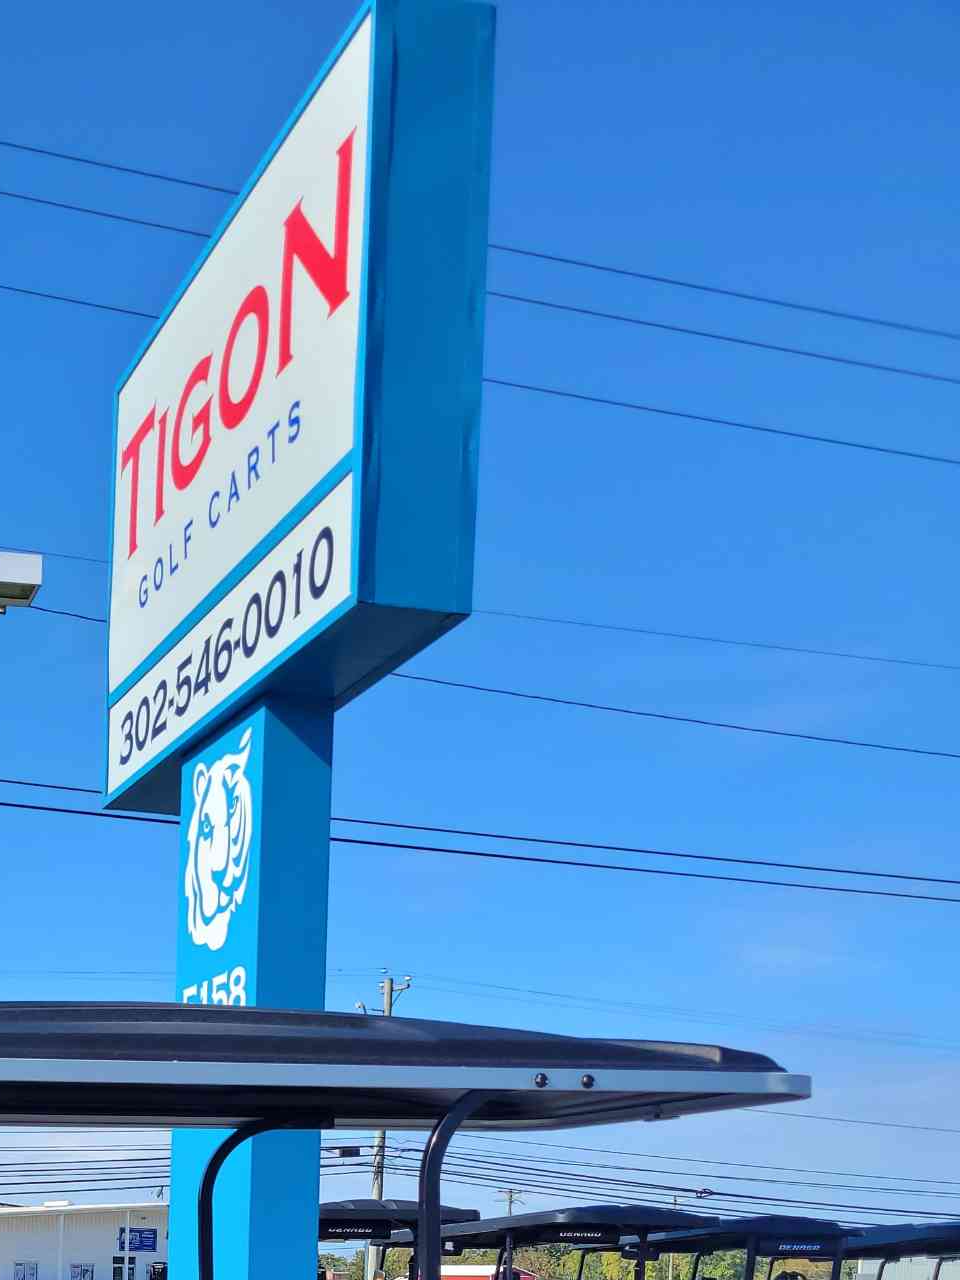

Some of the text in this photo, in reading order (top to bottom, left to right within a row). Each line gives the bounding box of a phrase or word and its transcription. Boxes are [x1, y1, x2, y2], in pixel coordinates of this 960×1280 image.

[121, 126, 356, 560] TIGON
[139, 400, 301, 608] GOLF CARTS
[120, 526, 334, 766] 302-546-0010
